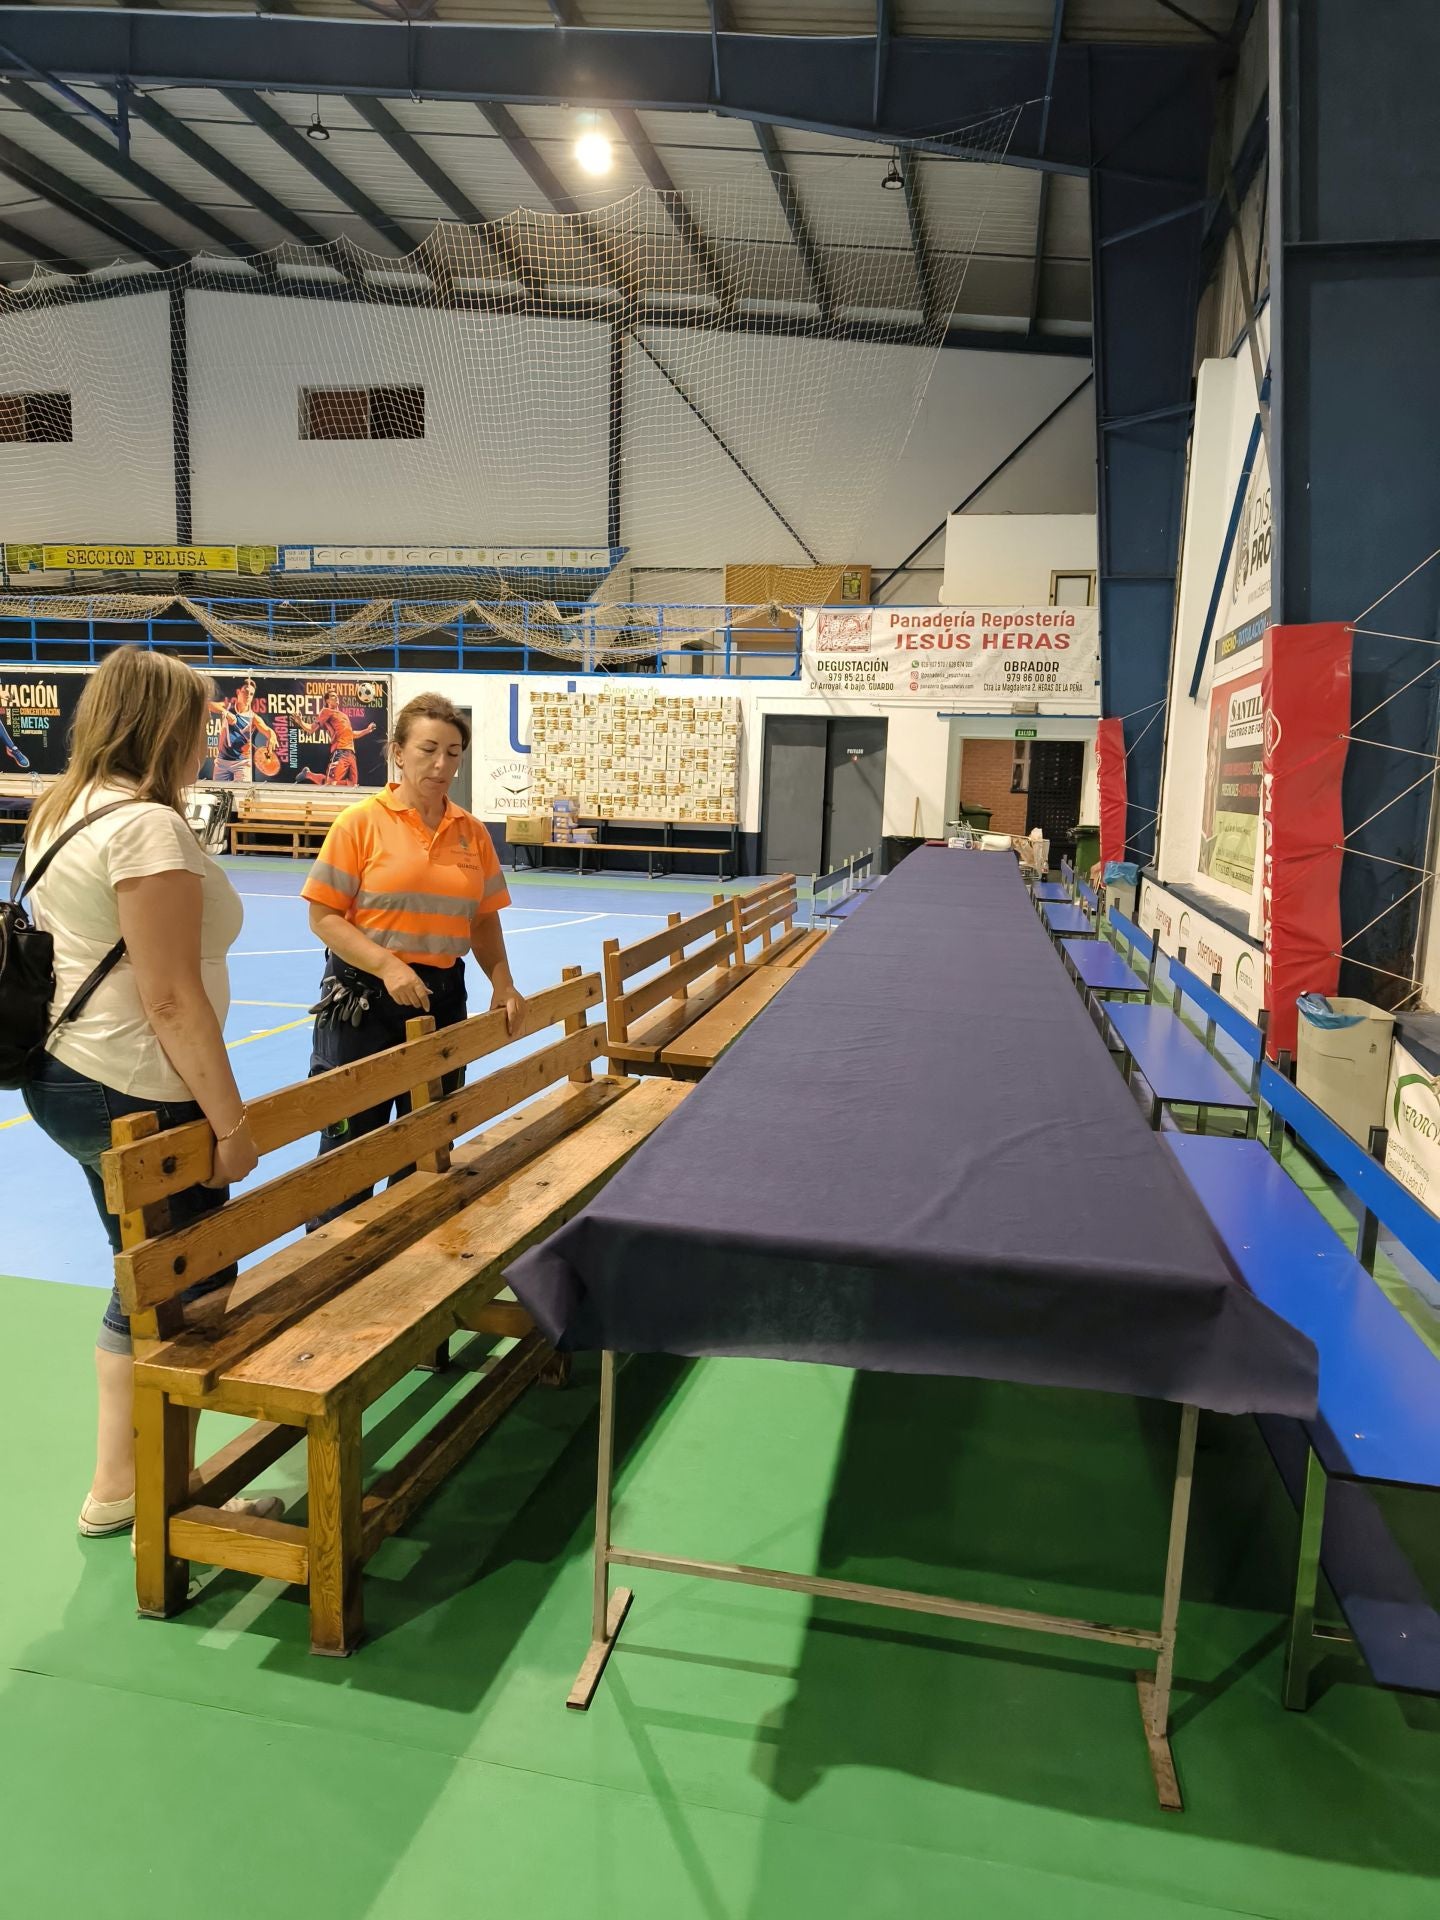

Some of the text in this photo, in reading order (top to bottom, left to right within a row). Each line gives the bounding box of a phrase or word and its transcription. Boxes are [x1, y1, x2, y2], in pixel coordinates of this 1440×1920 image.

[1253, 487, 1271, 535] DIS
[66, 549, 208, 567] SECCION PELUSA
[1250, 525, 1271, 577] PRO
[890, 610, 1075, 630] Panadería Repostería
[894, 628, 1071, 651] JESÚS HERAS
[817, 657, 889, 672] DEGUSTACIÓN
[1003, 661, 1060, 673] OBRADOR
[828, 673, 876, 682] 979 85 21 64
[1006, 673, 1057, 682] 979 86 00 80
[0, 680, 58, 708] VACIÓN
[306, 682, 383, 698] CONCENTRAN
[868, 683, 894, 691] GUARDO
[1002, 683, 1031, 693] Magdalena
[1038, 683, 1055, 692] HERAS
[1055, 683, 1062, 691] DE
[1062, 683, 1069, 692] LA
[1069, 681, 1083, 692] PEÑA
[267, 693, 323, 715] RESPET
[1231, 695, 1262, 722] SANTIL
[20, 716, 50, 730] METAS
[1229, 726, 1248, 738] CENTROS
[1248, 724, 1255, 735] DE
[298, 728, 331, 744] BALAN
[289, 728, 298, 769] MOTIVACIÓN
